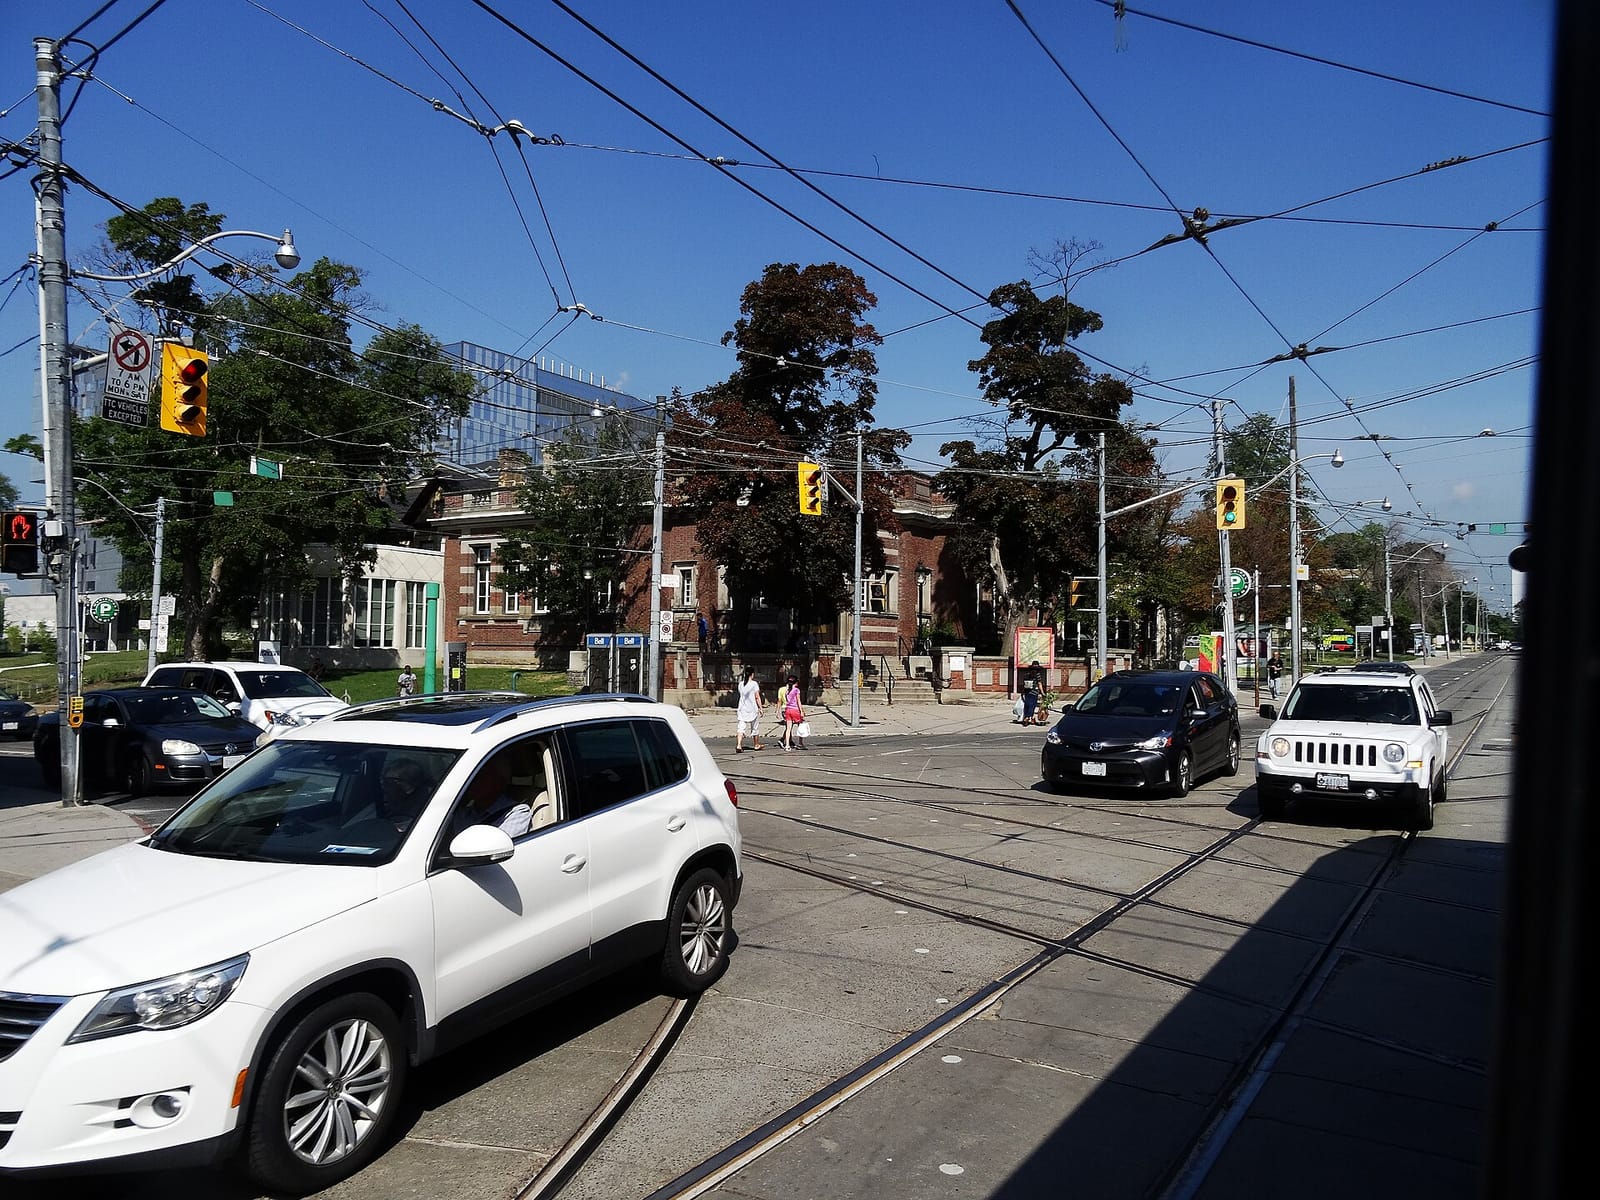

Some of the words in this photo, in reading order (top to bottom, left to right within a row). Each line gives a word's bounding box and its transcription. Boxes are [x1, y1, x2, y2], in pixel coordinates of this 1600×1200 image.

[118, 367, 124, 377] 7
[128, 373, 140, 381] AM
[112, 377, 121, 386] TO
[124, 380, 130, 389] 6
[133, 383, 145, 392] PM
[104, 399, 116, 408] TTC
[117, 401, 148, 415] VEHICLES
[108, 410, 142, 424] EXCEPTED
[100, 603, 112, 614] P
[594, 637, 605, 645] Bell
[624, 637, 635, 645] Bell
